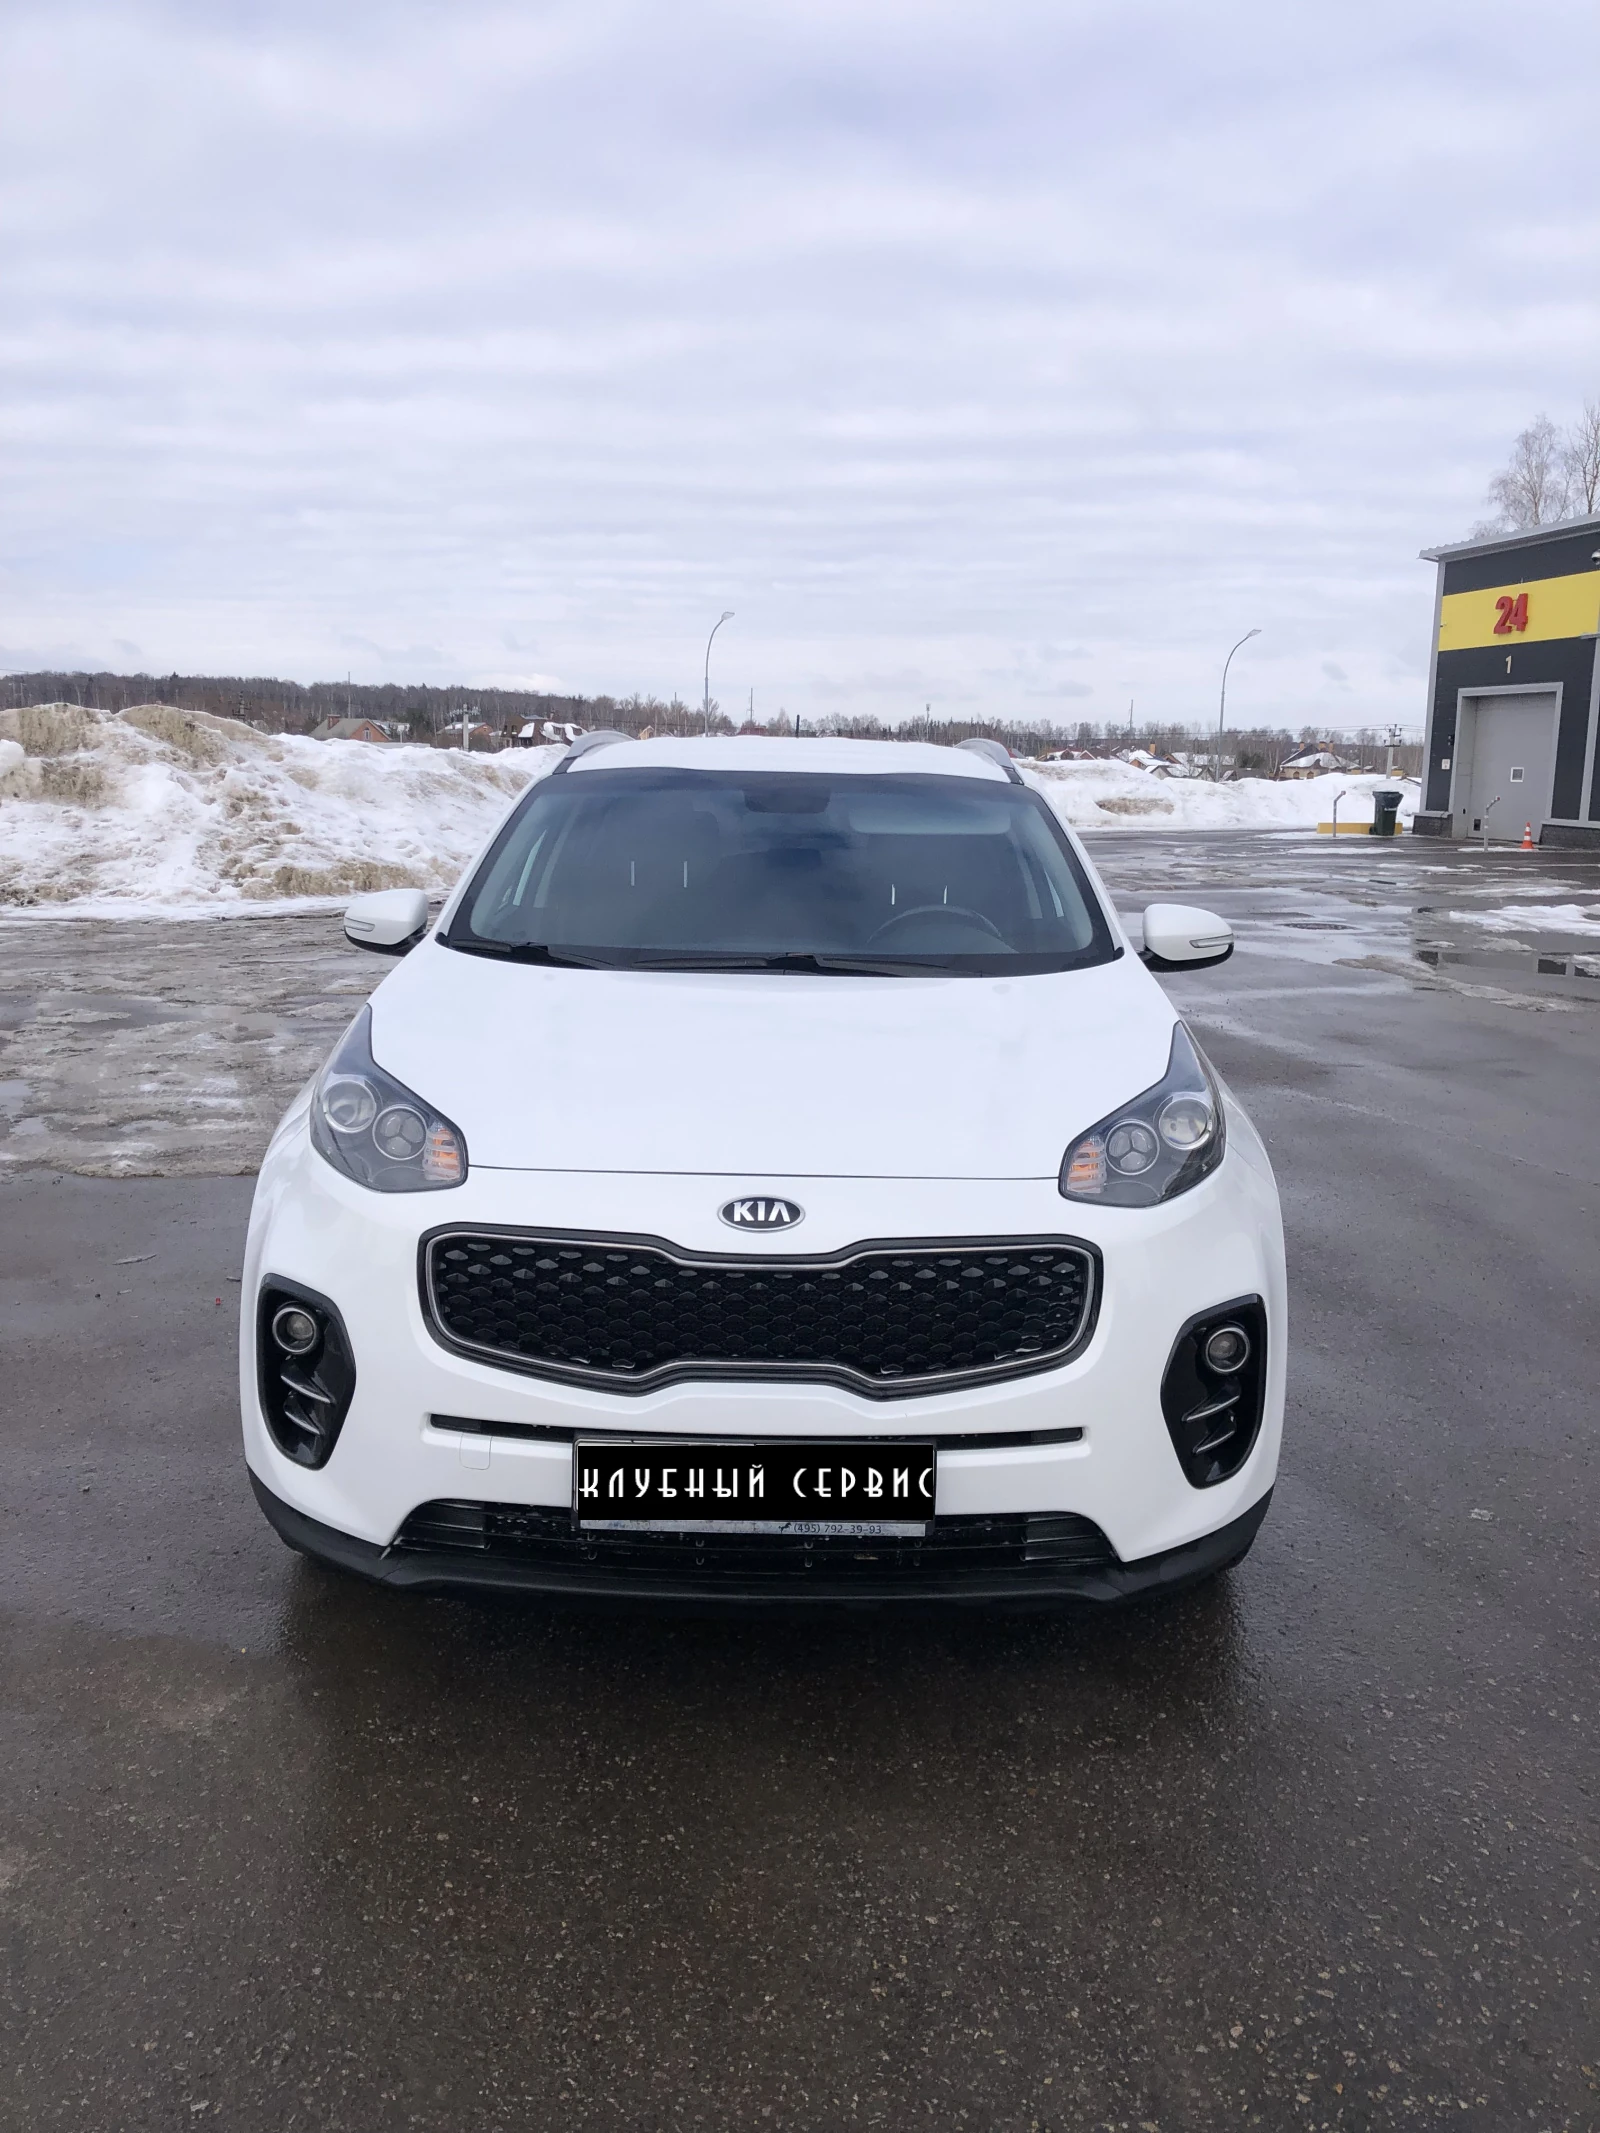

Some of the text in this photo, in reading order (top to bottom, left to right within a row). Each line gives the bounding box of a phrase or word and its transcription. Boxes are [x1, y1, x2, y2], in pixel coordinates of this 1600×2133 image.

[1493, 593, 1529, 635] 24
[1505, 655, 1512, 674] 1
[733, 1201, 791, 1222] KIA
[793, 1523, 882, 1534] (495) 792-39-93
